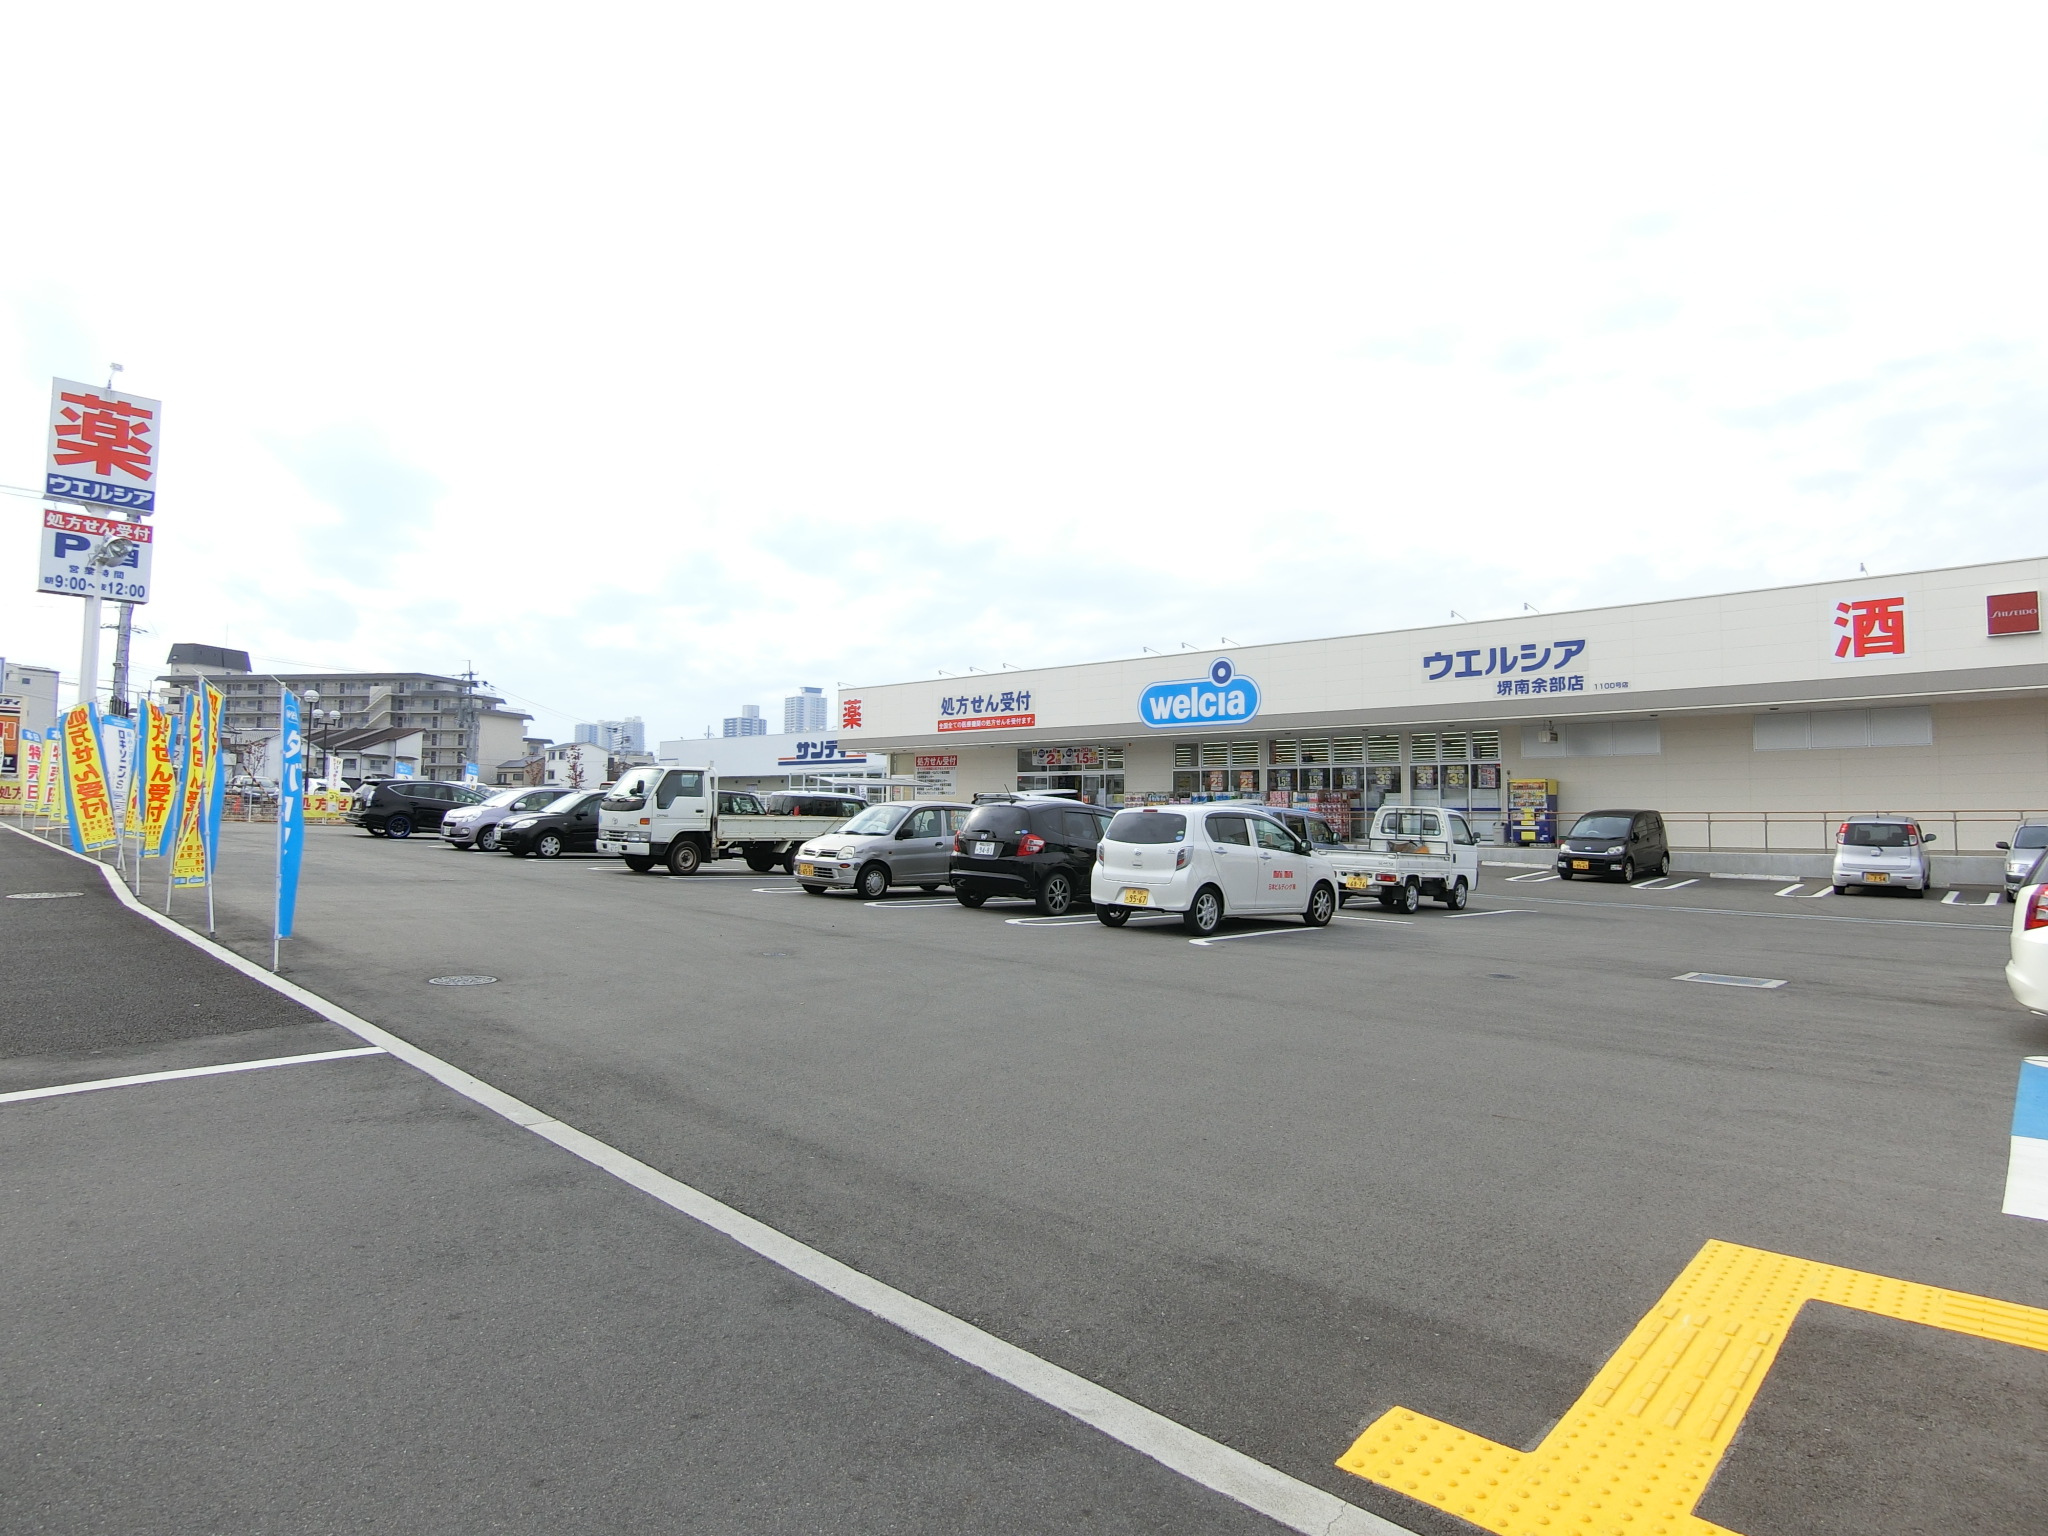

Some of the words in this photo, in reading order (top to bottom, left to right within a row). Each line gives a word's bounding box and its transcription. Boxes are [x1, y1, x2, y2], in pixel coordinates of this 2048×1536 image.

[53, 391, 153, 482] 薬
[50, 476, 153, 506] ウエルシア
[46, 512, 152, 542] 処方せん受付
[54, 531, 91, 559] P
[1833, 596, 1906, 659] 酒
[1989, 608, 2038, 619] SHISEIDO
[1422, 638, 1586, 682] ウエルシア
[1496, 674, 1585, 696] 堺南余部店
[1593, 681, 1629, 690] 1100号店
[842, 698, 863, 731] 薬
[940, 690, 1032, 717] 処方せん受付
[1148, 684, 1247, 721] welcia
[916, 755, 957, 766] 処方せん受付
